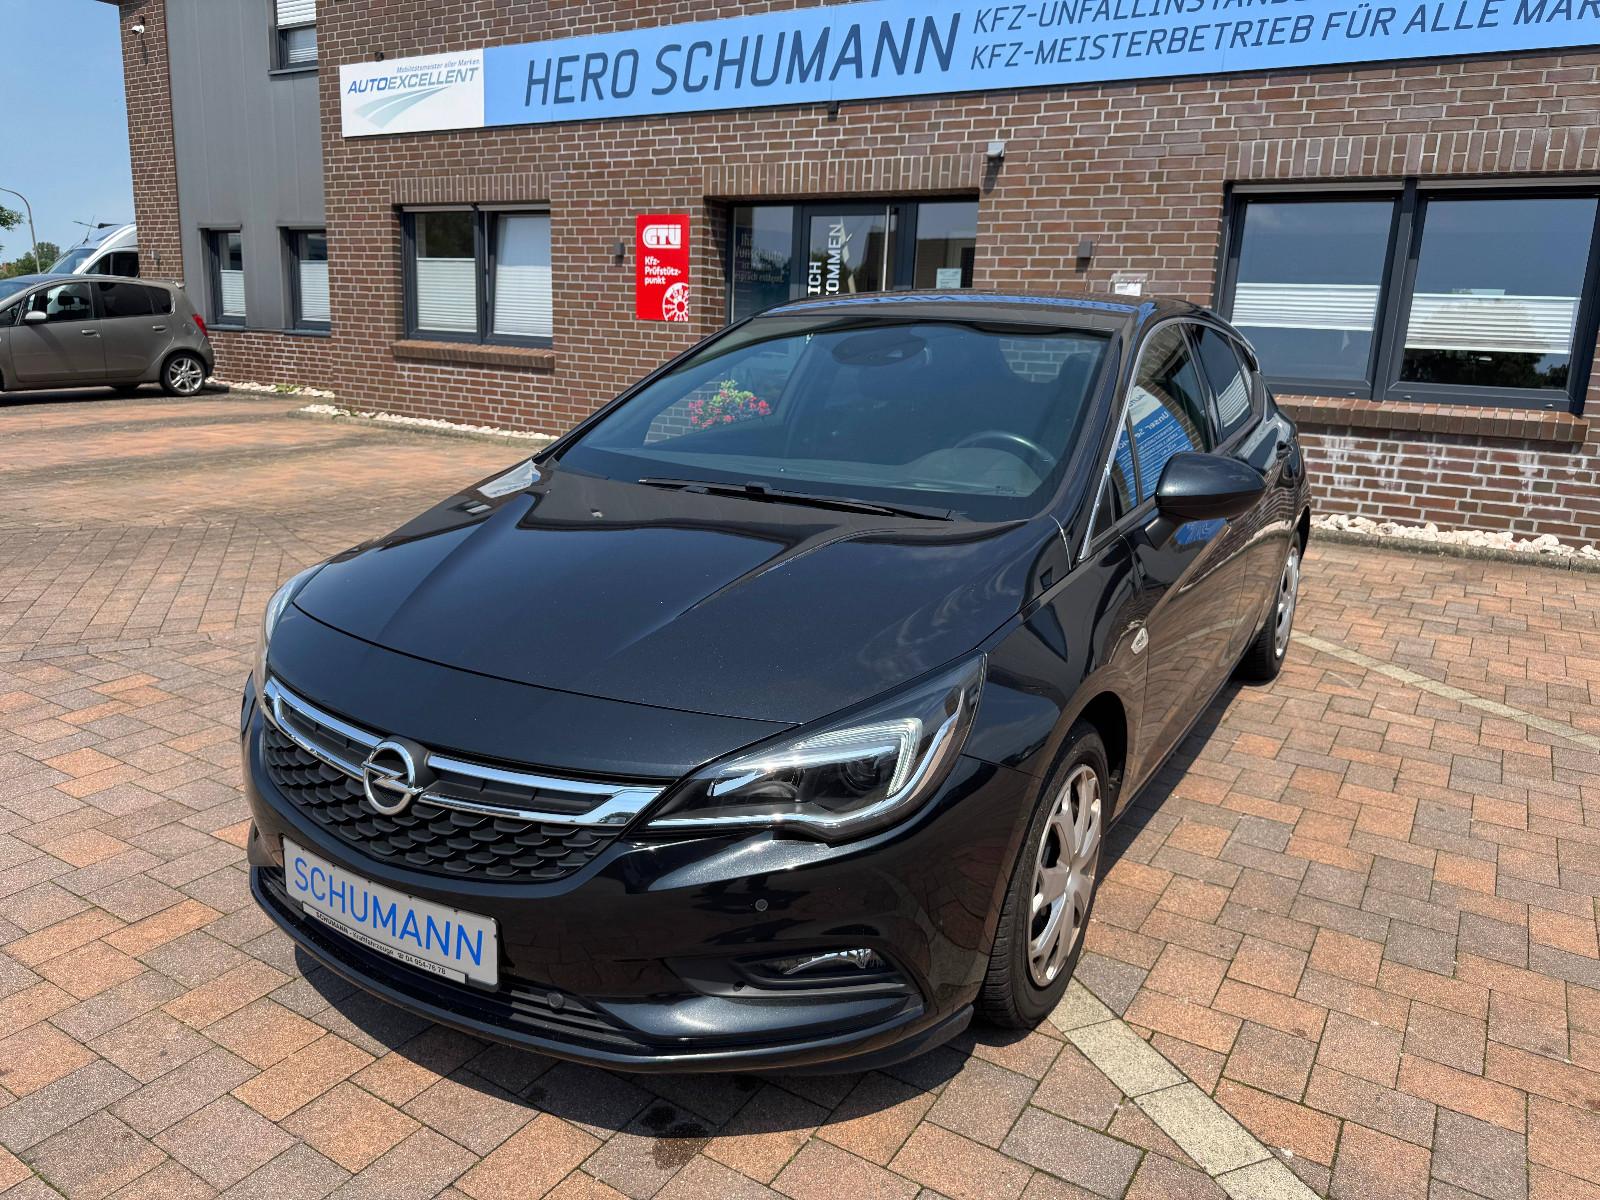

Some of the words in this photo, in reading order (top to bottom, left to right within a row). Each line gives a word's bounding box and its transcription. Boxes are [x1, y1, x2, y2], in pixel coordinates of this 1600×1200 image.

[971, 14, 1315, 70] KFZ-MEISTERBETRIEB
[1321, 3, 1397, 41] FÜR
[1402, 0, 1499, 35] ALLE
[524, 48, 639, 107] HERO
[651, 12, 961, 95] SCHUMANN
[347, 67, 479, 95] AUTOEXCELLENT
[644, 266, 681, 276] Prüfstütz-
[644, 276, 666, 286] punkt
[294, 856, 483, 966] SCHUMANN
[316, 911, 349, 935] SCHUMANN
